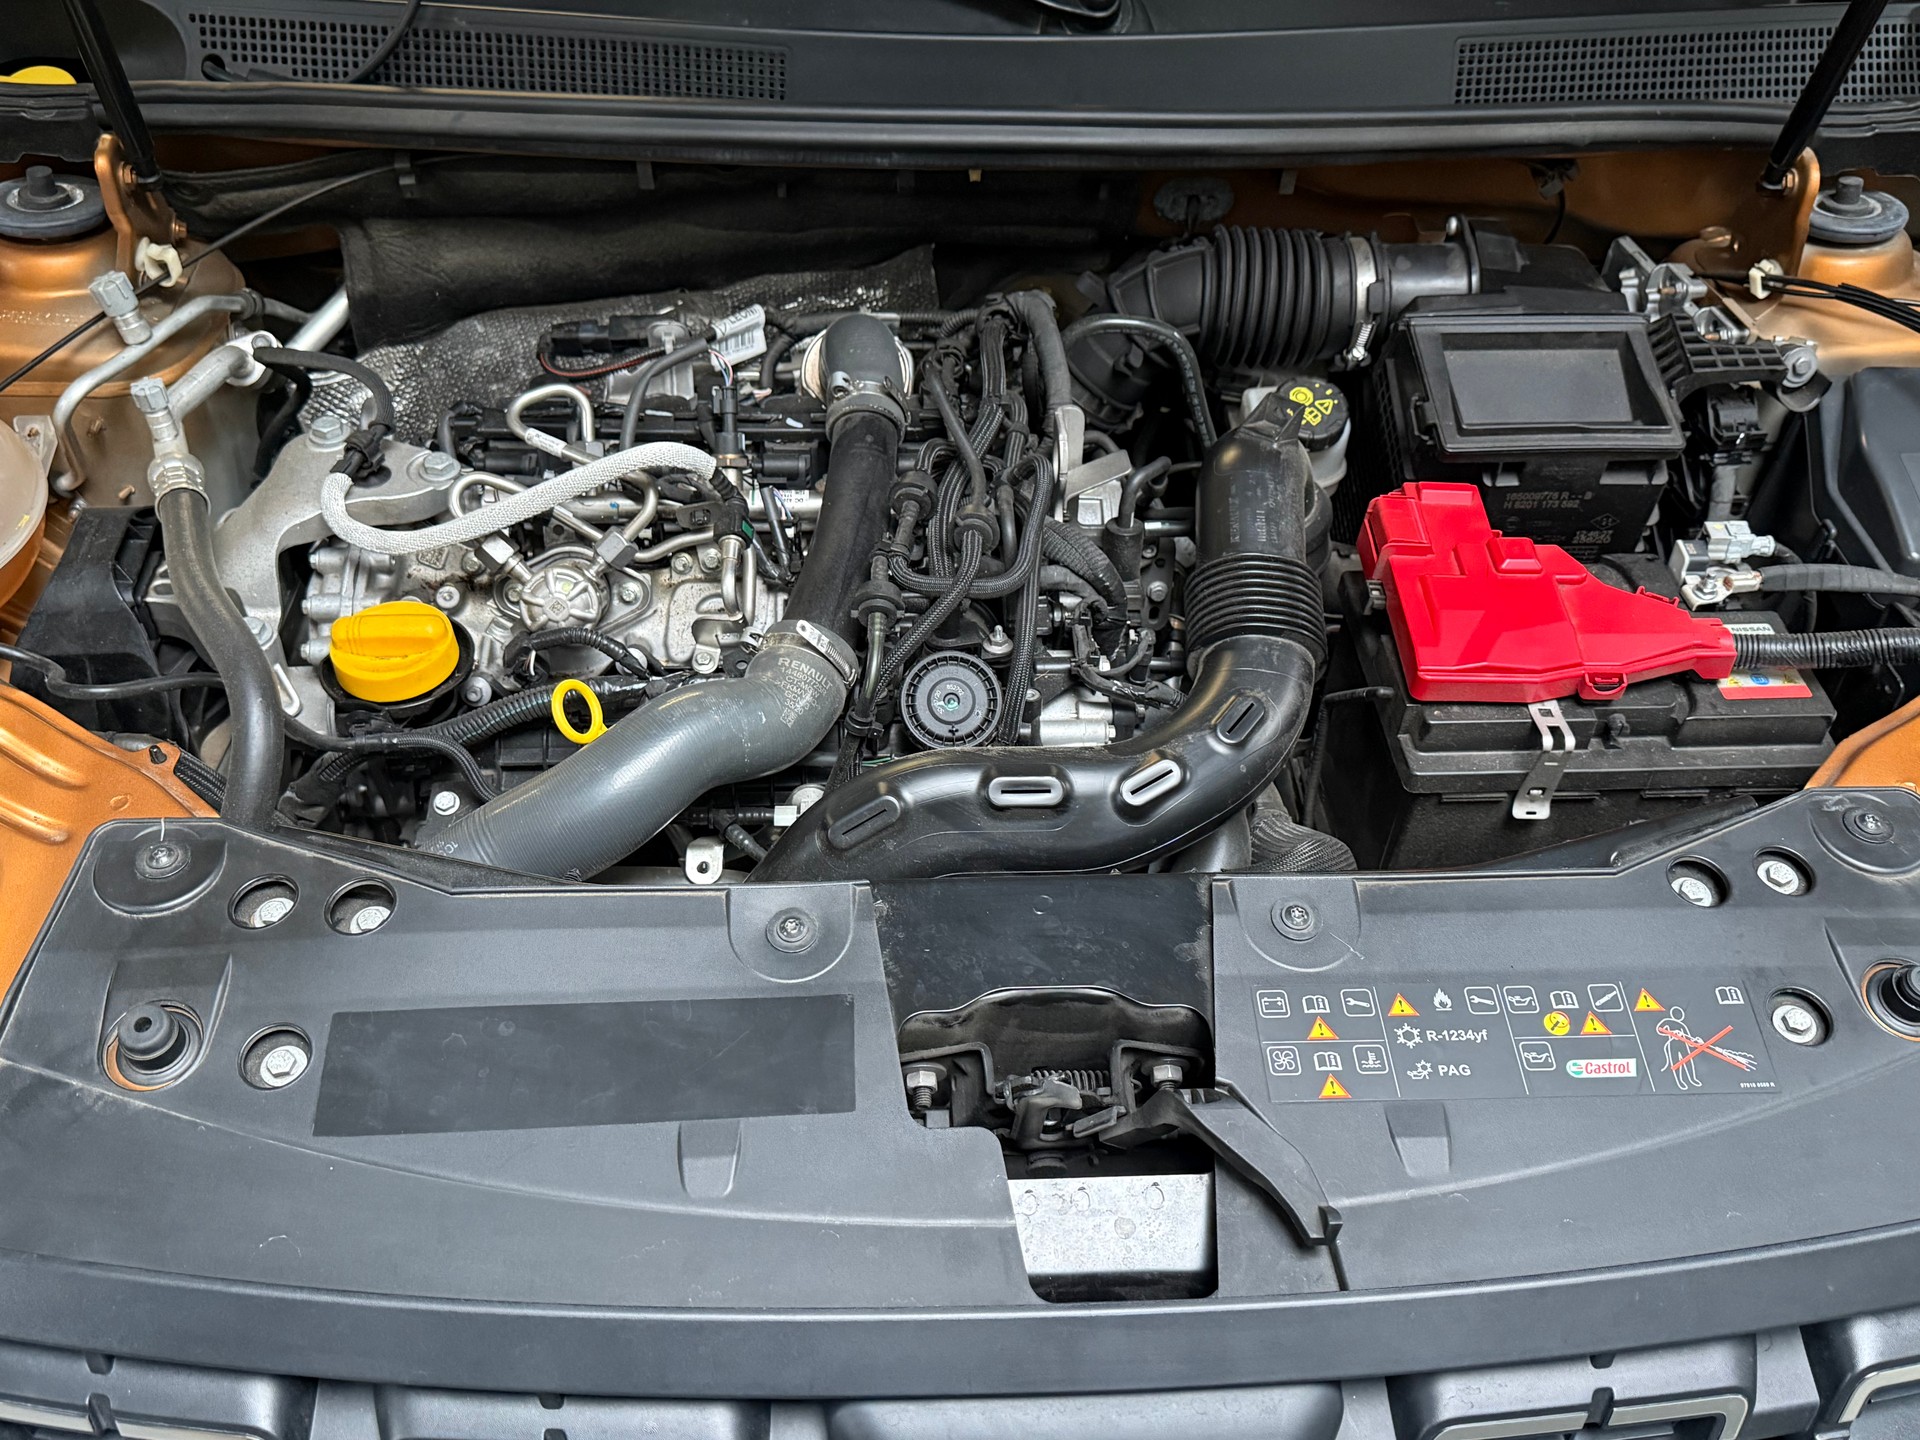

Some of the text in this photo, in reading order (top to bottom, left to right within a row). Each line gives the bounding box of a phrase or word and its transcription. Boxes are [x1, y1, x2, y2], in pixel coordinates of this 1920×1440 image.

[778, 657, 833, 690] RENAULT
[1426, 1029, 1488, 1043] R-1234yf
[1438, 1064, 1471, 1077] PAG
[1585, 1062, 1631, 1074] Castrol
